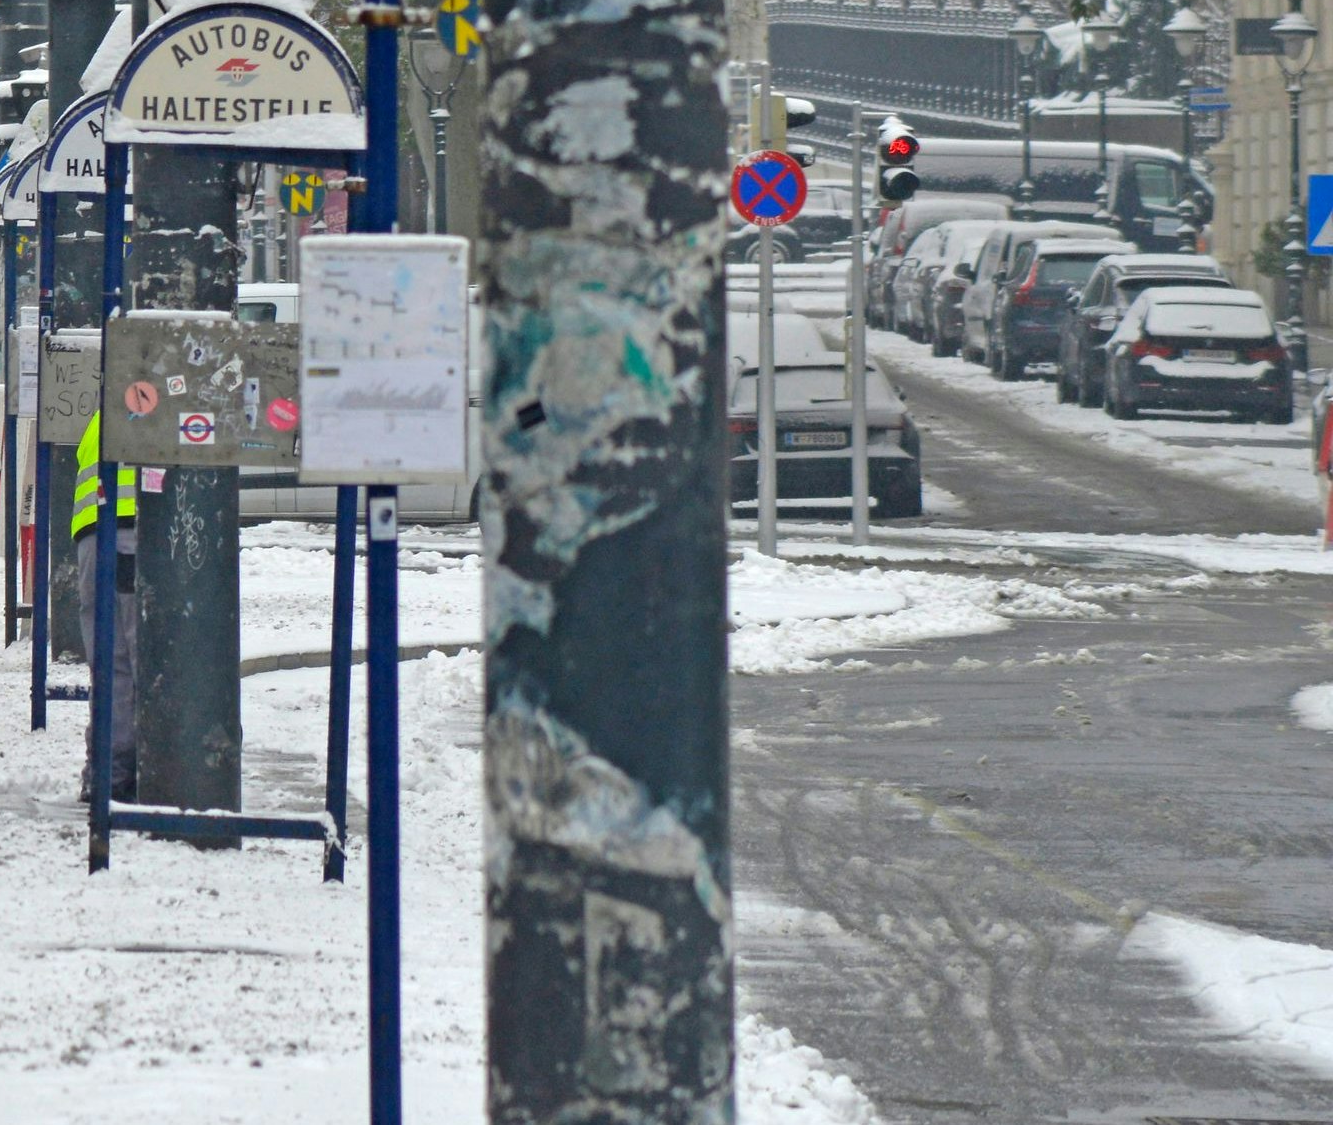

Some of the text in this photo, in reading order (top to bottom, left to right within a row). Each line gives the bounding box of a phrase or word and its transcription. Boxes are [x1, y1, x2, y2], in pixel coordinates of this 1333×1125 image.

[171, 23, 311, 72] AUTOBUS
[290, 186, 314, 214] N
[753, 215, 782, 226] ENDE
